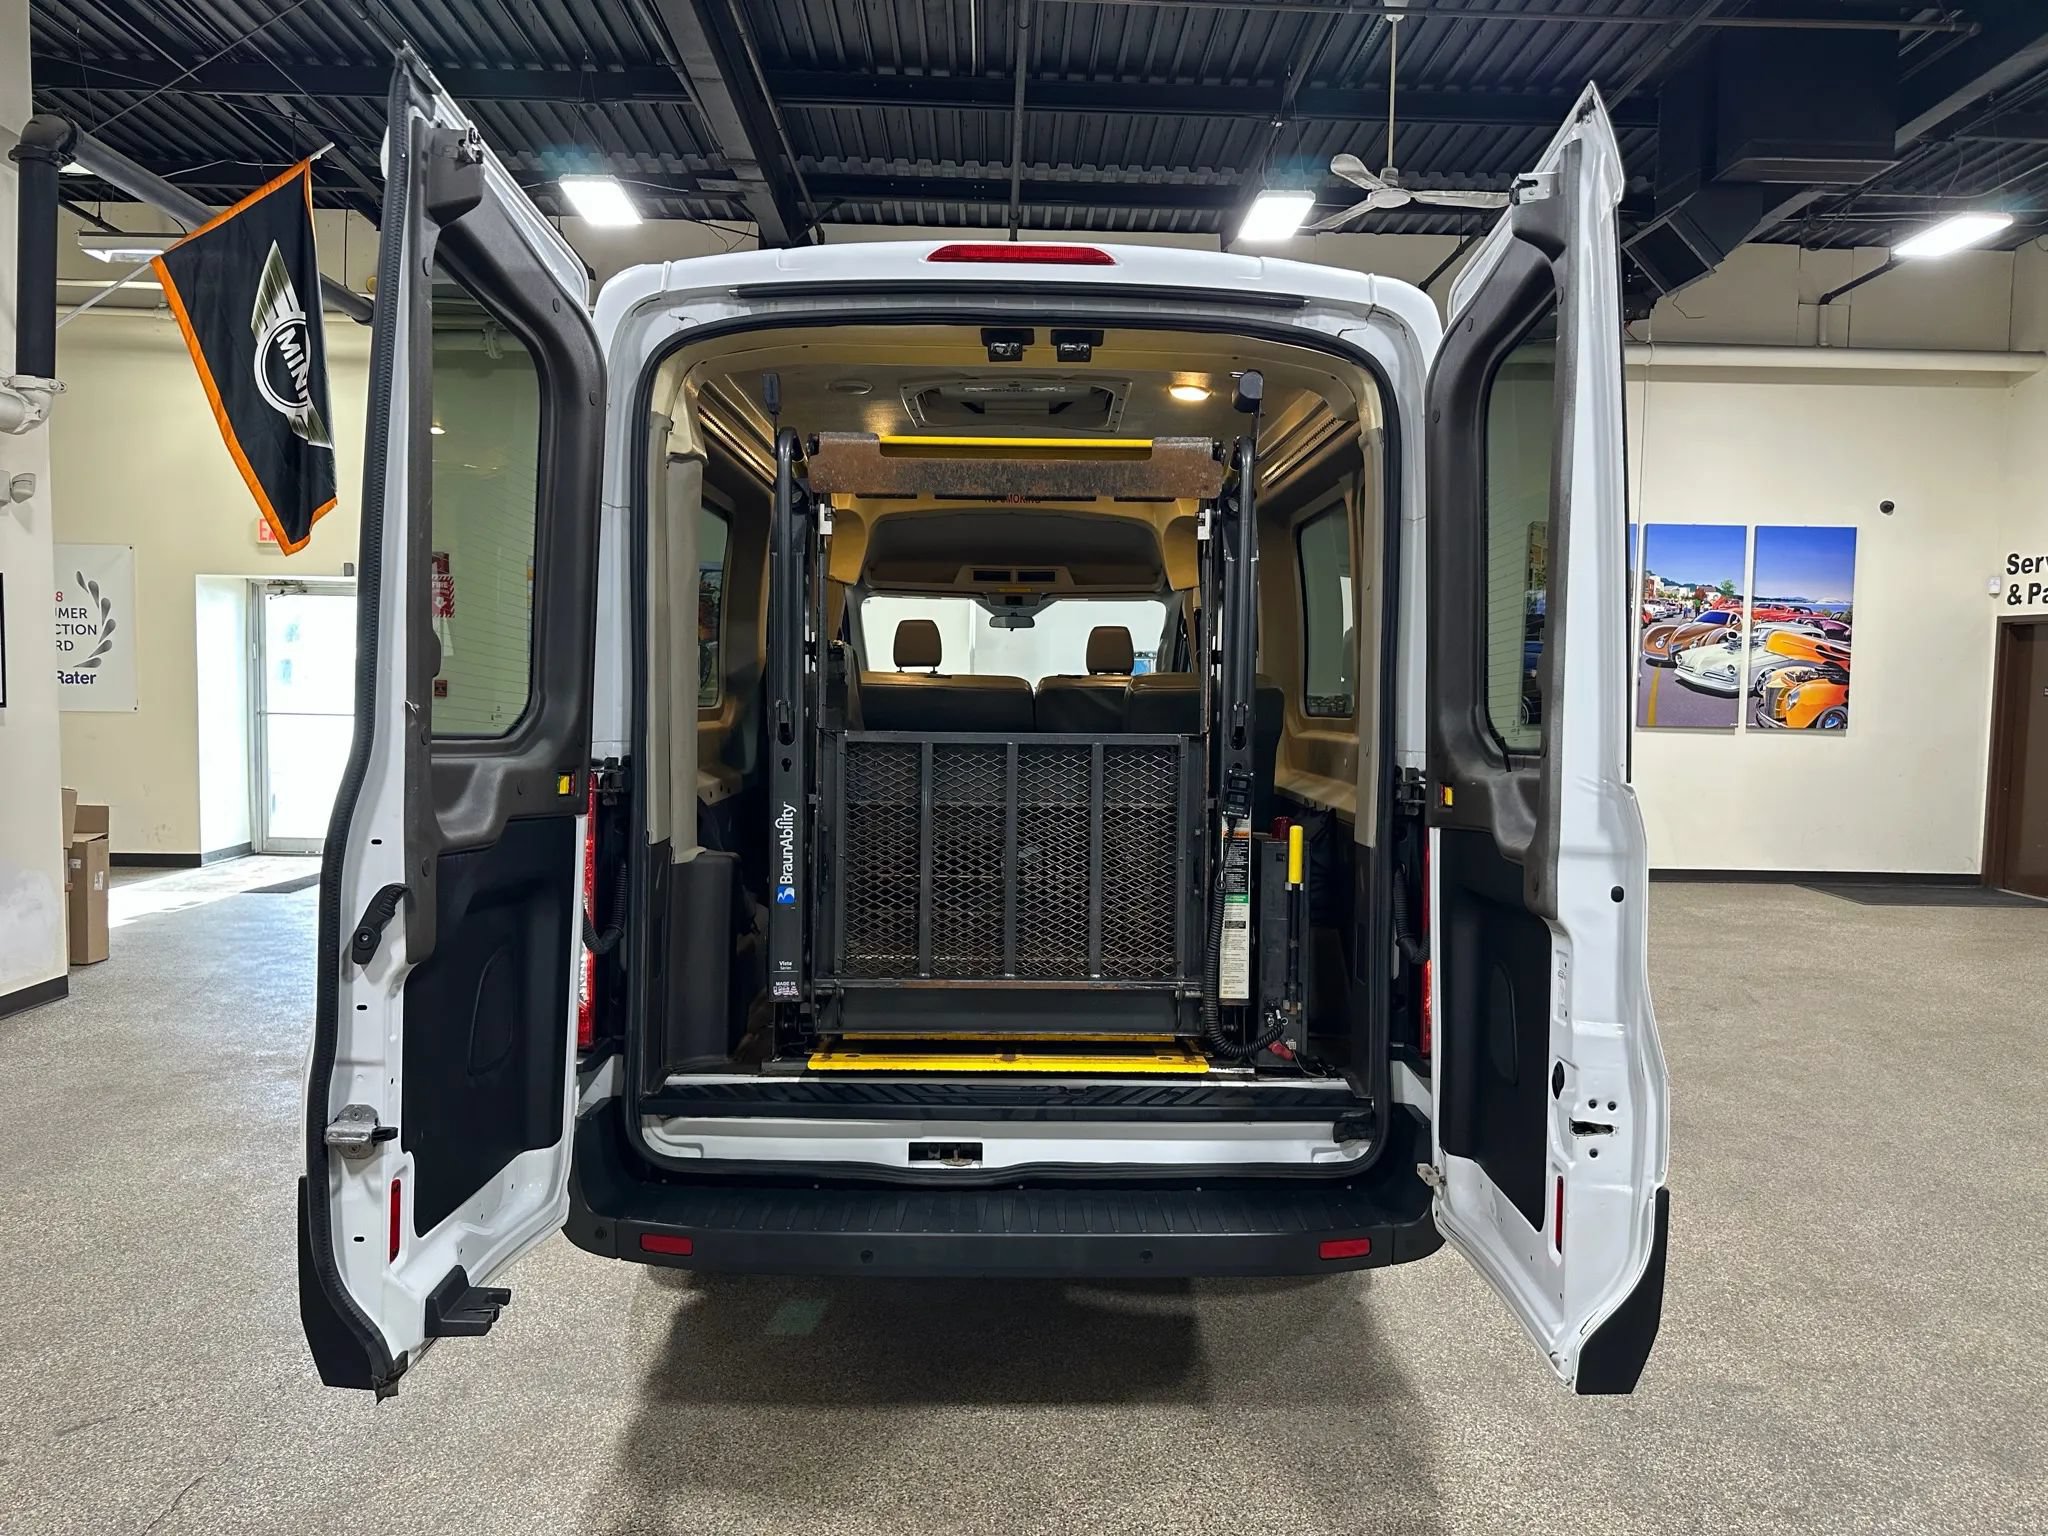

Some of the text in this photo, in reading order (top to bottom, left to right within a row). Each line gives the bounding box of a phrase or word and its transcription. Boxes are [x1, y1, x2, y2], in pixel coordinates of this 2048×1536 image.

[276, 327, 308, 401] MINI
[2006, 553, 2048, 575] Ser
[2007, 584, 2022, 606] &
[55, 607, 88, 619] MER
[775, 801, 797, 885] BraunAbility
